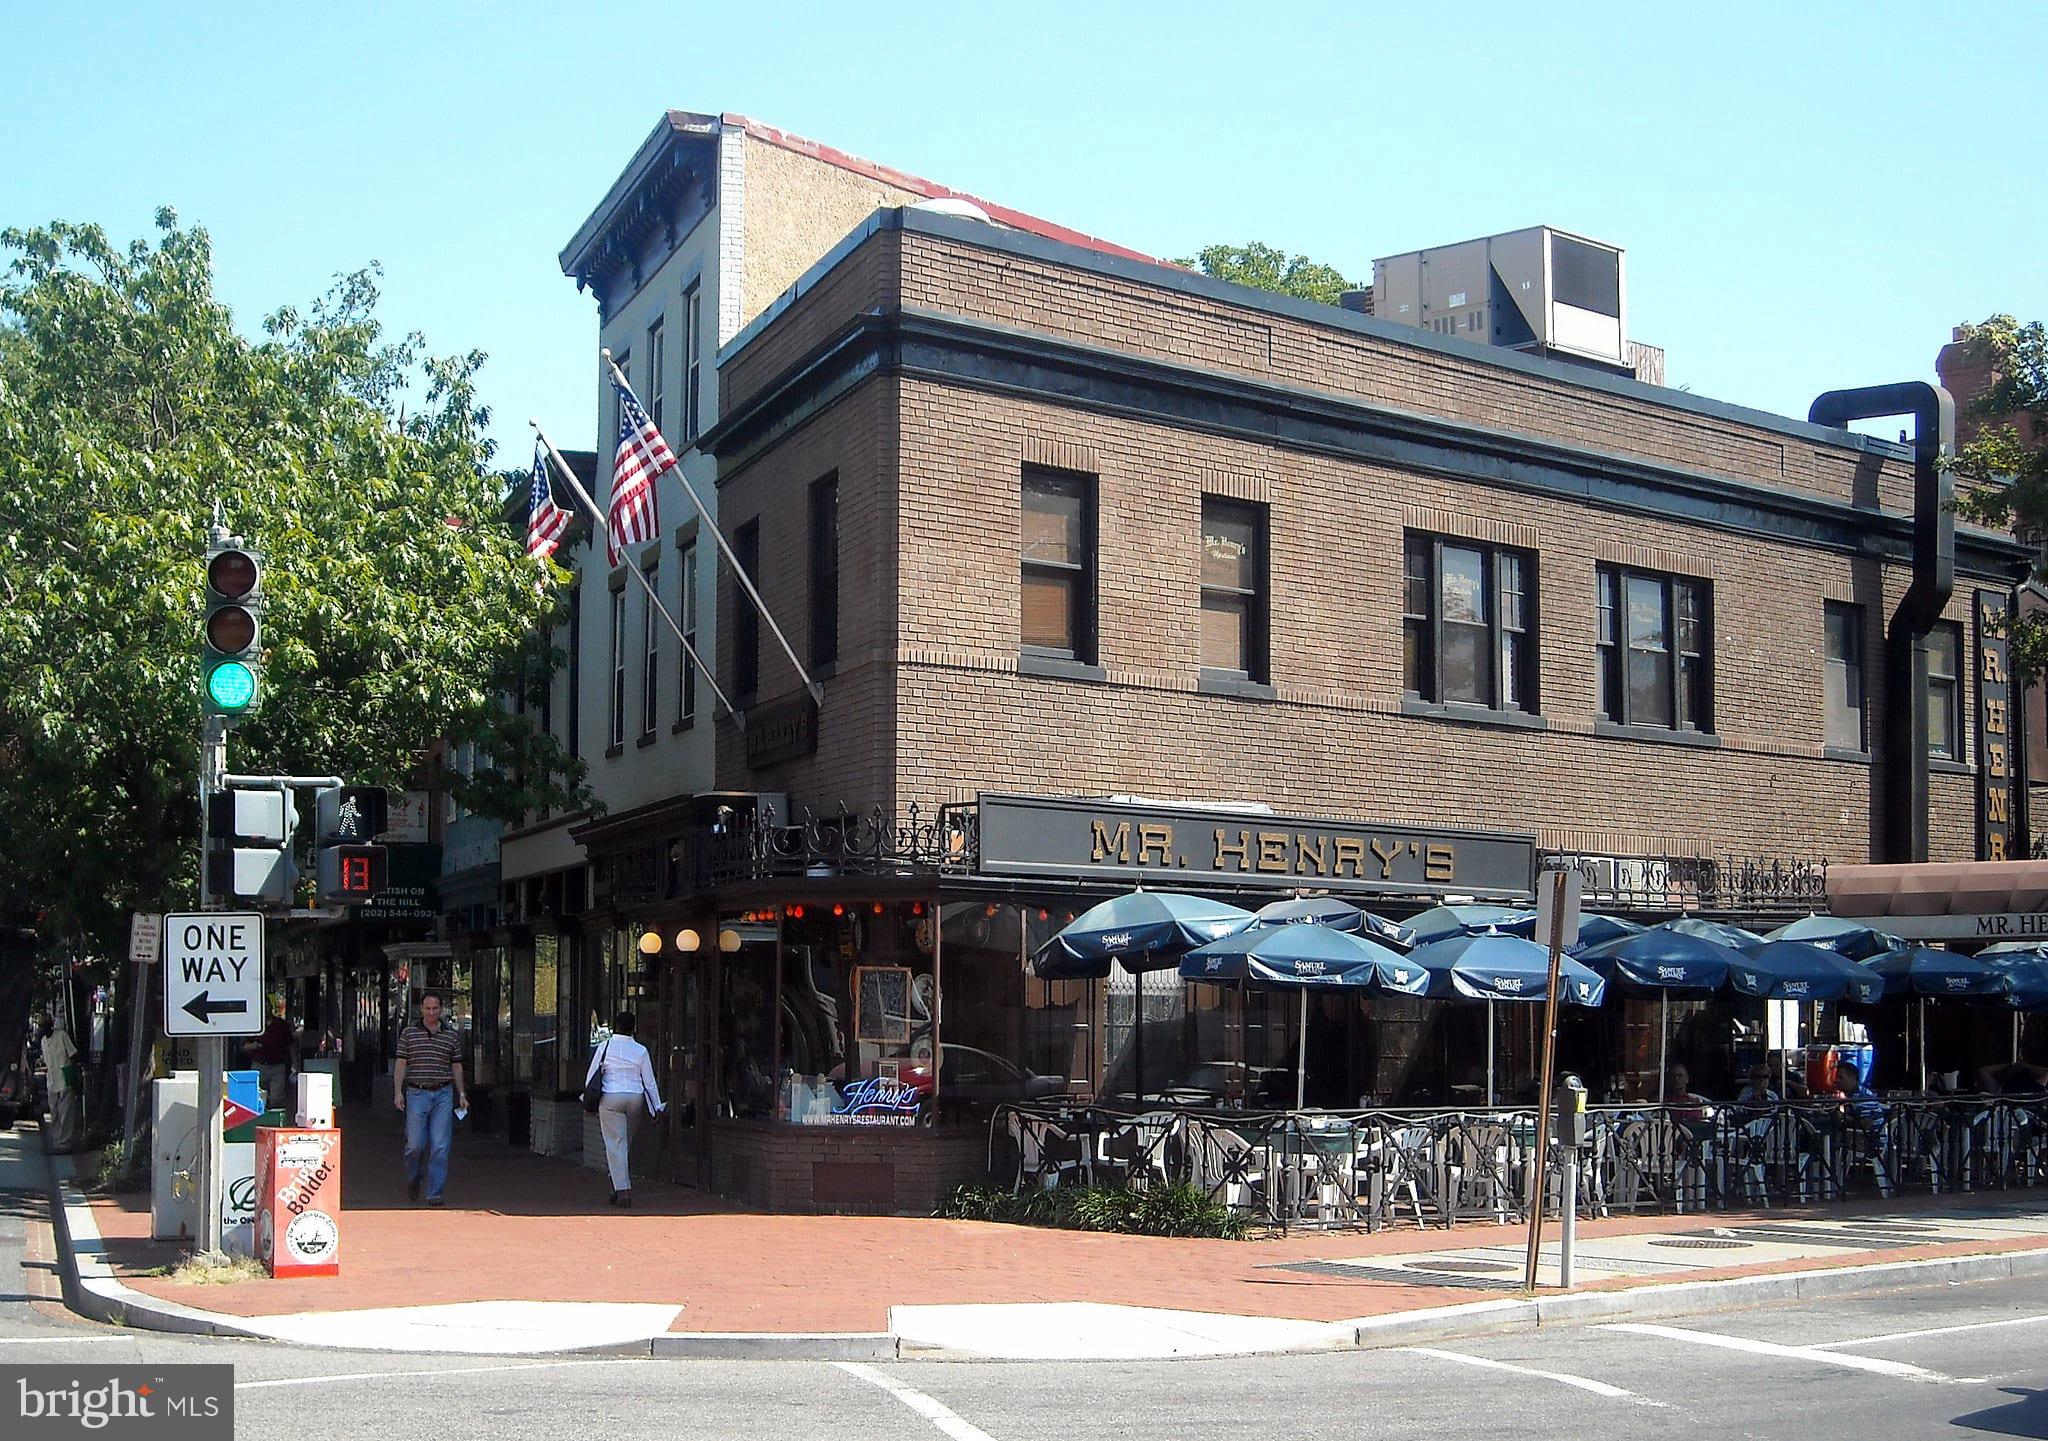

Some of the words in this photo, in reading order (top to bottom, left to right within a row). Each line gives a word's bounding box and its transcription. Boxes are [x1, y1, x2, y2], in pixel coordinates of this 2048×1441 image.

[1986, 698, 2008, 862] HENR
[1091, 820, 1187, 867] MR.
[1214, 828, 1454, 881] HENRY'S
[343, 857, 369, 891] 13
[410, 887, 425, 896] ON
[376, 898, 396, 907] THE
[399, 898, 420, 907] HILL
[360, 908, 386, 919] (202)
[1976, 916, 2014, 936] MR.
[2021, 915, 2048, 934] HE
[183, 924, 246, 951] ONE
[181, 956, 248, 983] WAY
[1295, 960, 1327, 970] SAMUEL
[1658, 965, 1687, 976] SAMUEL
[1494, 977, 1523, 987] SAMUEL
[833, 1077, 920, 1113] Henry's
[286, 1159, 336, 1217] Bolder.
[223, 1215, 239, 1226] the
[240, 1215, 255, 1226] ON
